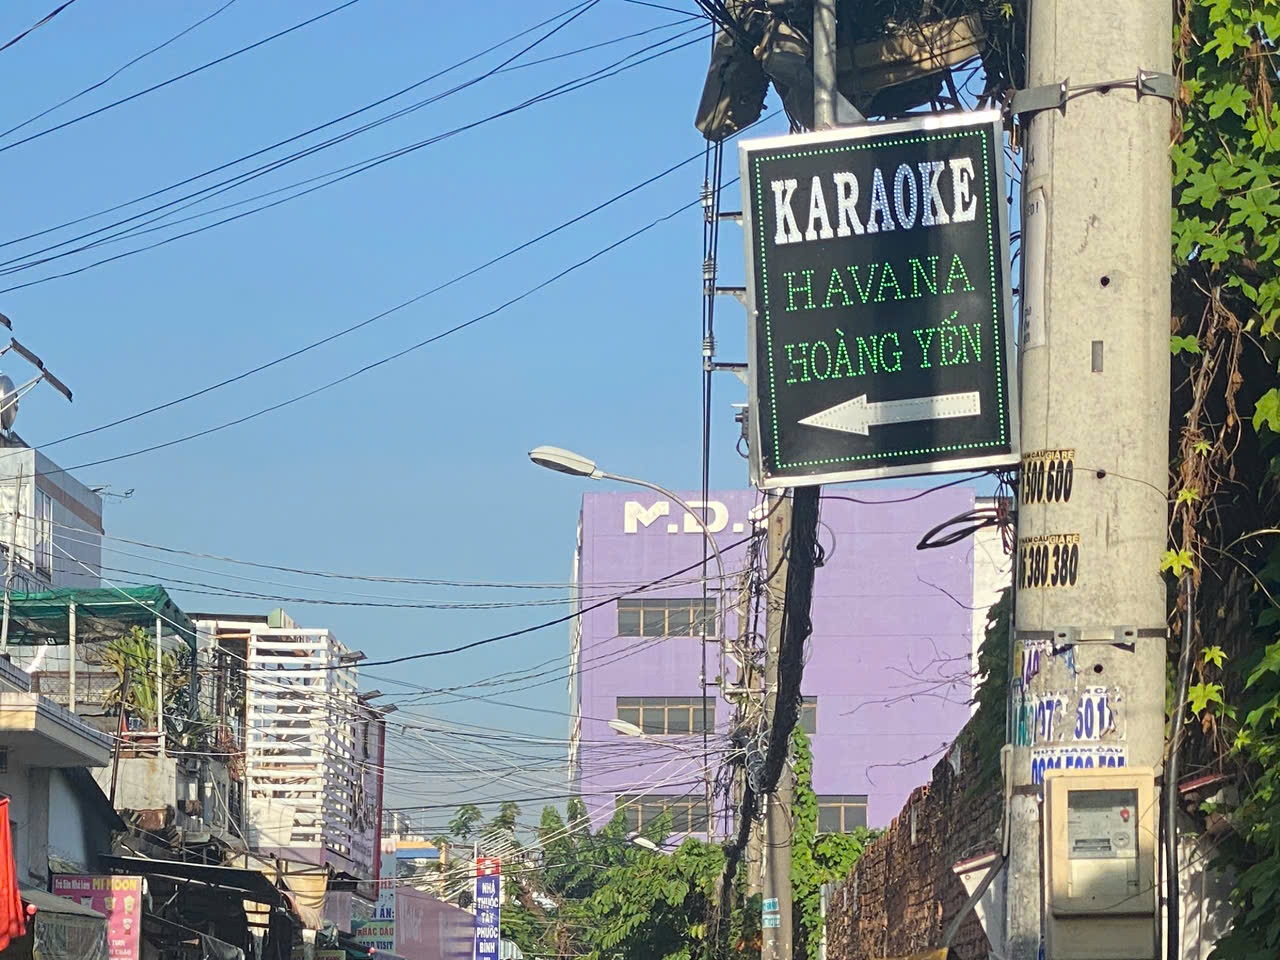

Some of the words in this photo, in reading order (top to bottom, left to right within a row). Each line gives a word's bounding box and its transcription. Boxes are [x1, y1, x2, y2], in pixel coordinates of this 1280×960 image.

[771, 157, 978, 244] KARAOKE
[783, 254, 976, 311] HAVANA
[785, 328, 903, 384] HOÀNG
[912, 310, 982, 368] YẾN
